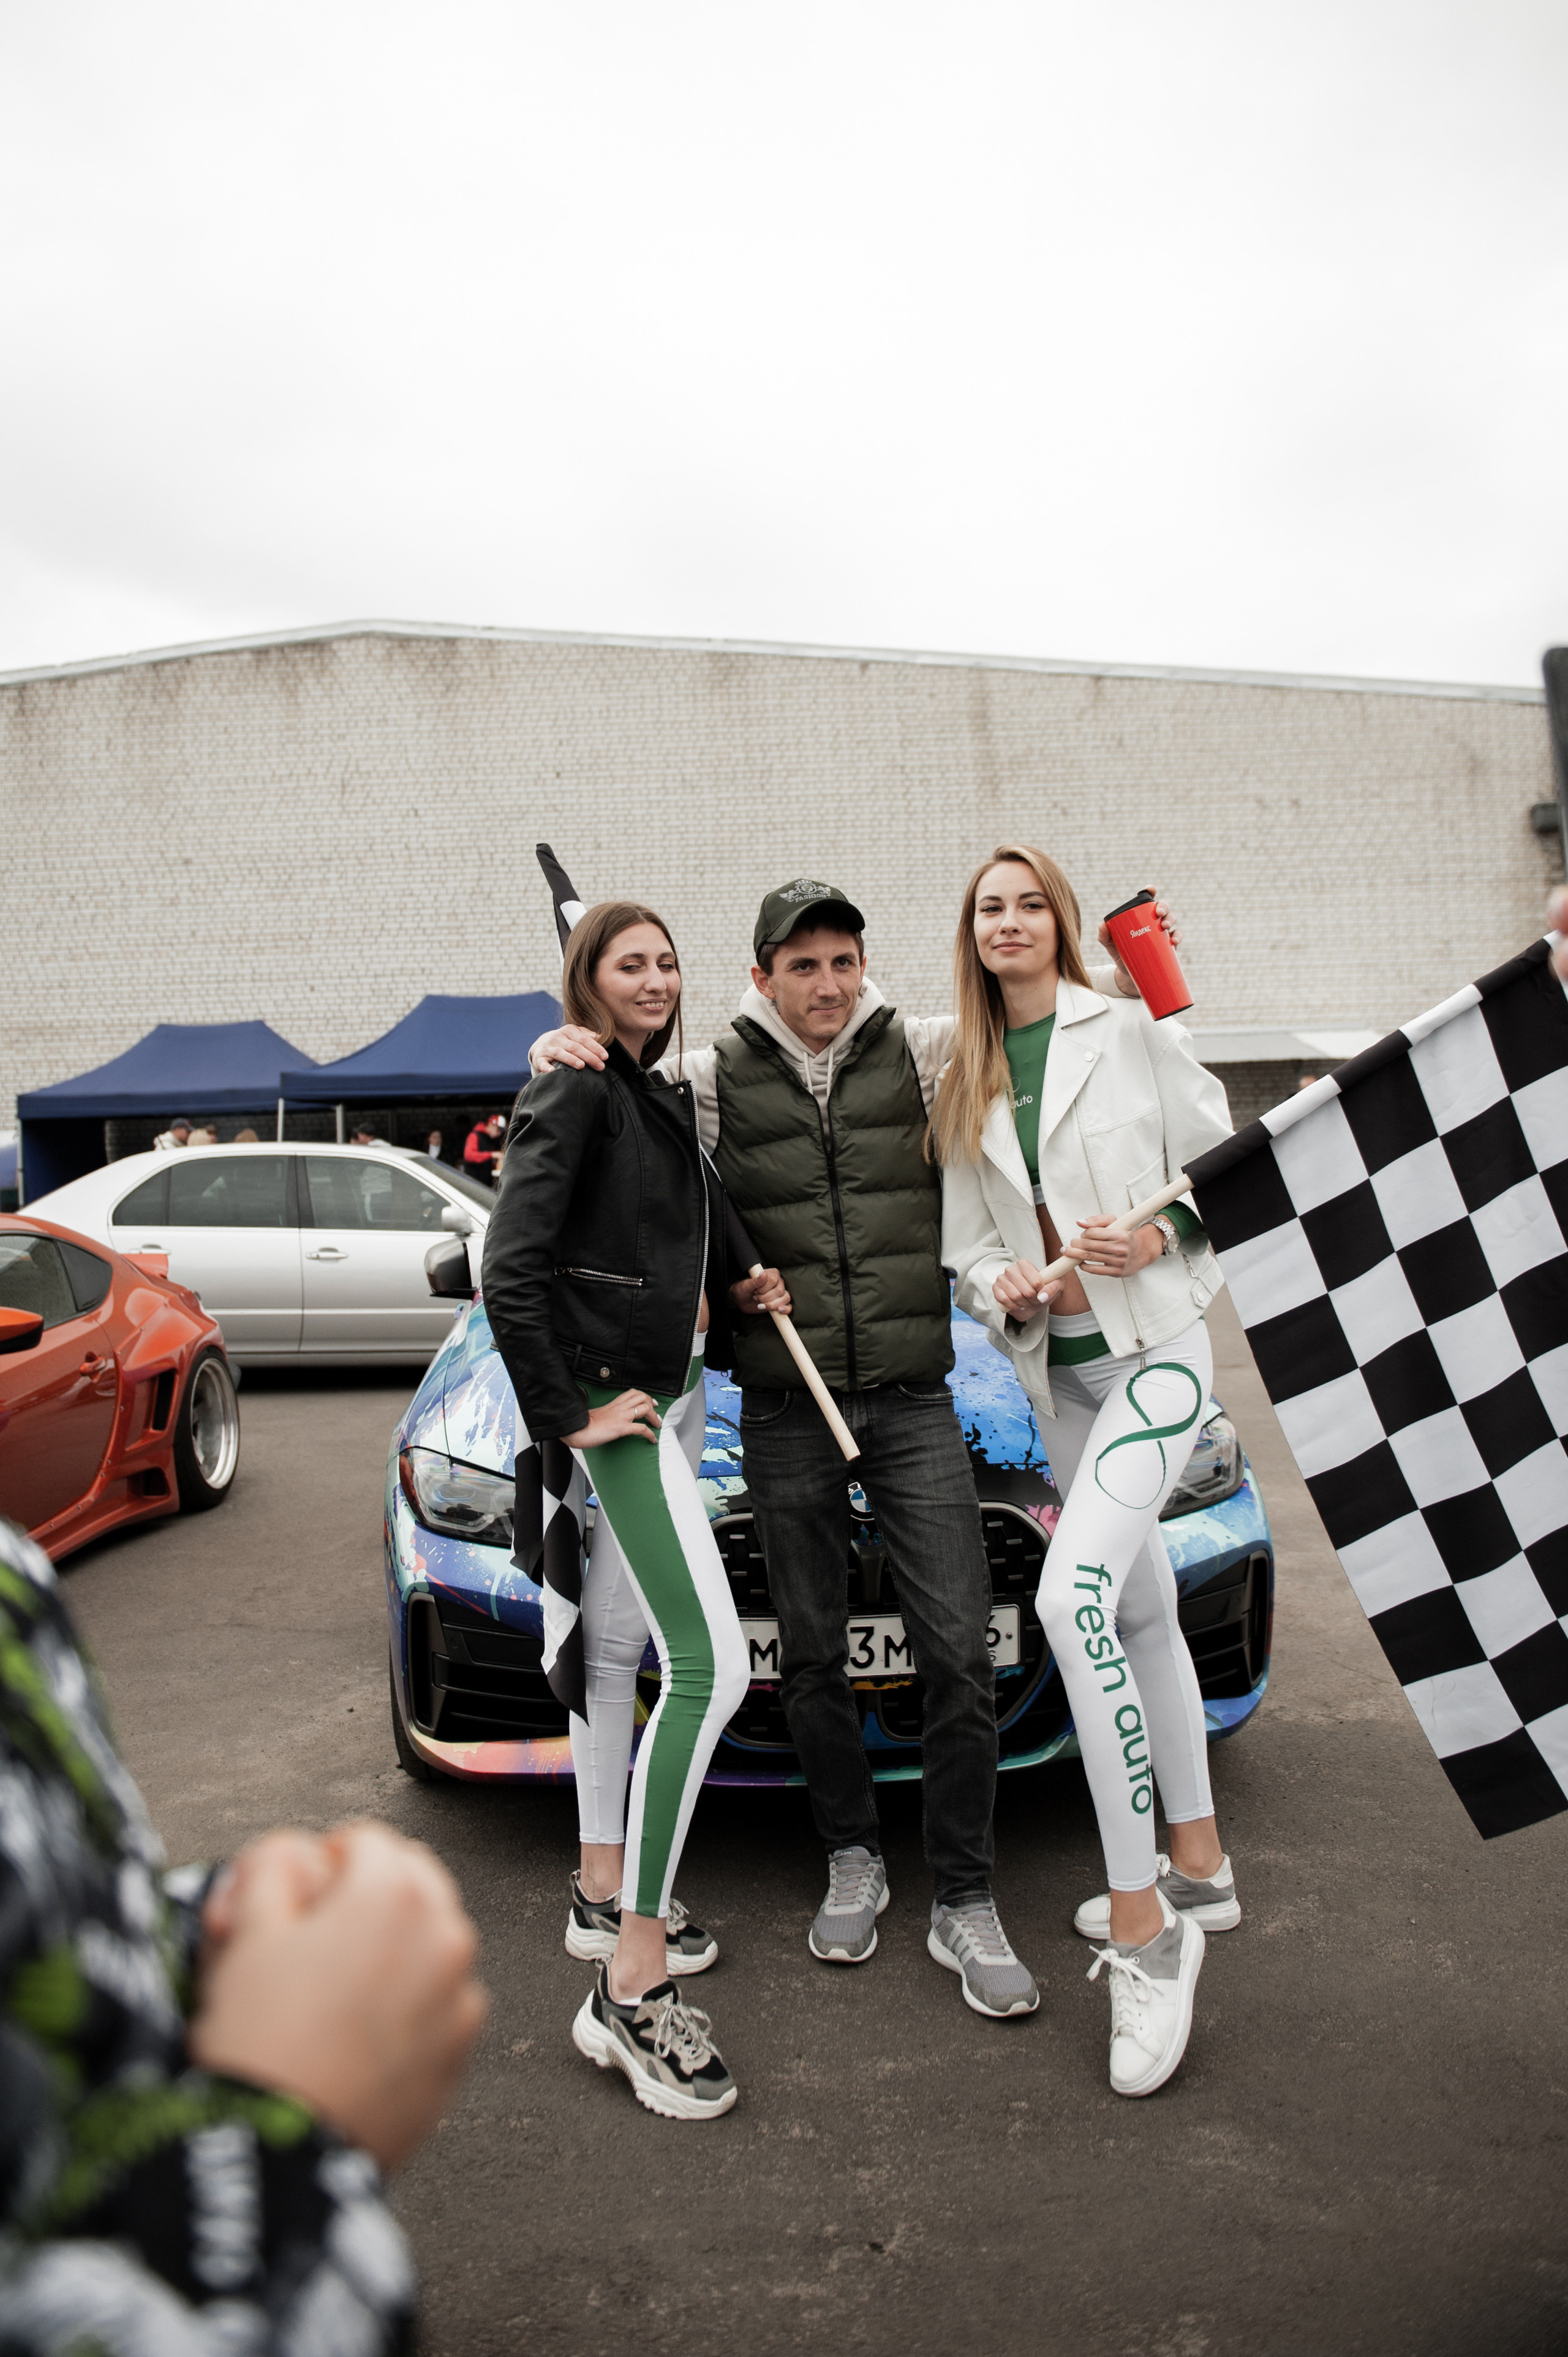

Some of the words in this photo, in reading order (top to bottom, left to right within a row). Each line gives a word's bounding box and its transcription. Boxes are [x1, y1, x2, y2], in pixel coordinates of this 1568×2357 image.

[1129, 926, 1152, 939] Яндекс
[1011, 1094, 1033, 1109] auto
[1074, 1563, 1126, 1693] fresh
[1114, 1704, 1152, 1815] auto
